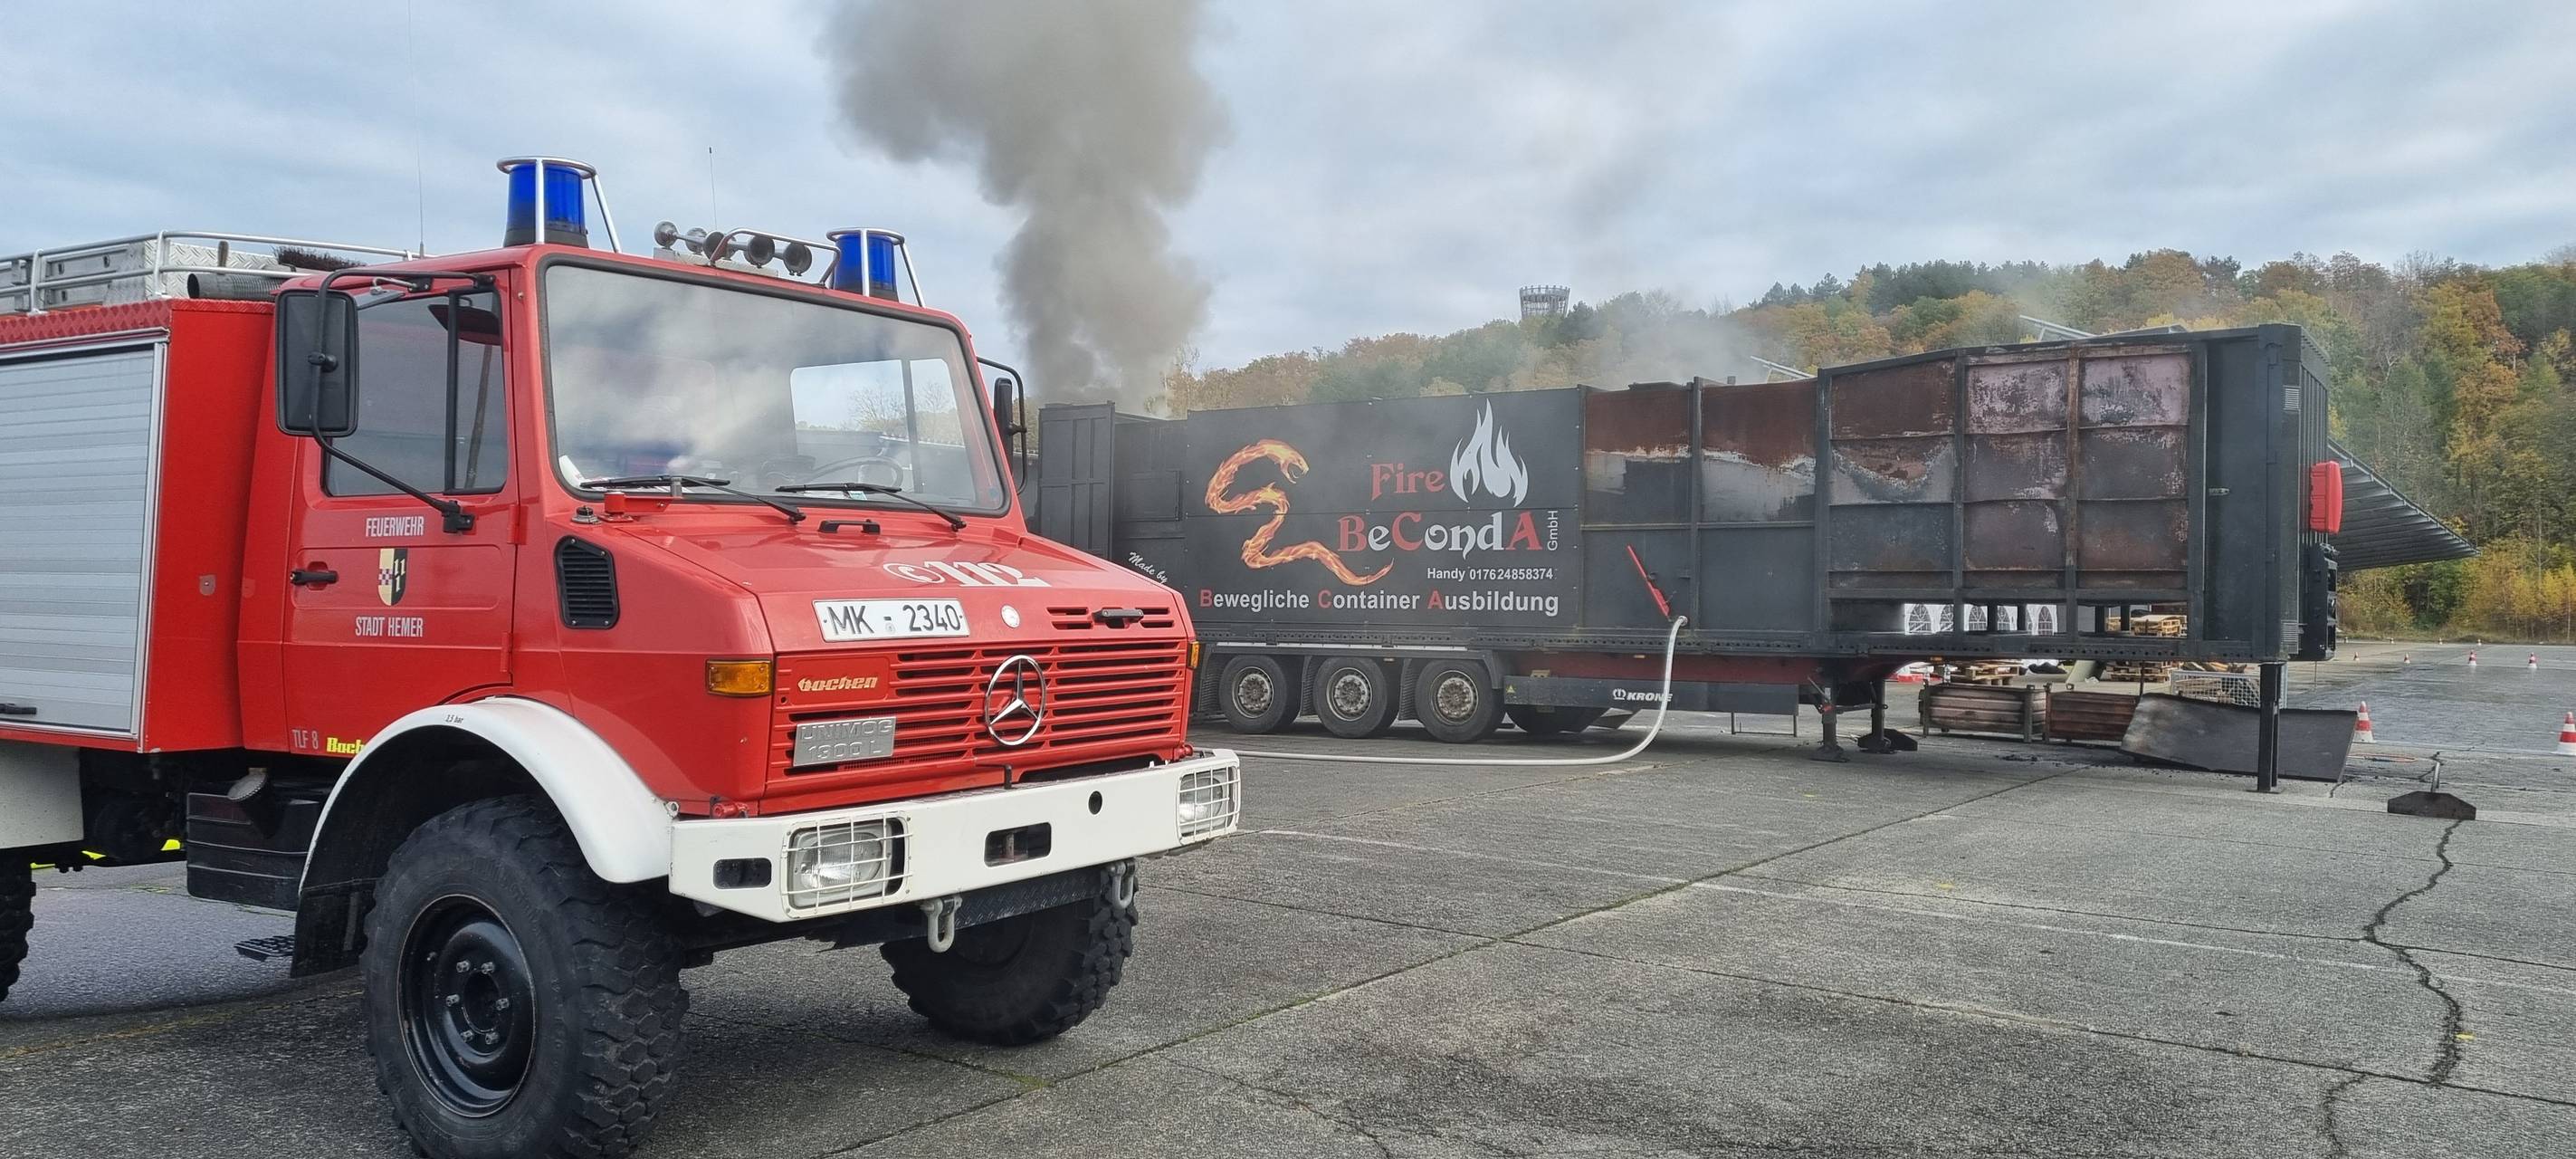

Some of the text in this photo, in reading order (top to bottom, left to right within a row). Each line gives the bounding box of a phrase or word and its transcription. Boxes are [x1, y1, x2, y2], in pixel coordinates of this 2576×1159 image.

[1370, 463, 1445, 501] Fire
[366, 516, 425, 537] FEUERWEHR
[1337, 511, 1542, 560] BeCondA
[1547, 510, 1559, 551] GmbH
[923, 560, 1052, 587] 112
[1128, 551, 1169, 584] Made by
[1427, 568, 1553, 581] Handy 017624858374
[1199, 589, 1559, 617] Bewegliche Container Ausbildung
[355, 617, 424, 637] STADT HEMER
[827, 605, 874, 635] MK
[902, 604, 961, 631] 2340
[1627, 692, 1674, 702] KRONE
[291, 729, 319, 750] TLF 8
[800, 719, 892, 740] UNIMOG
[807, 740, 882, 761] 1300 L
